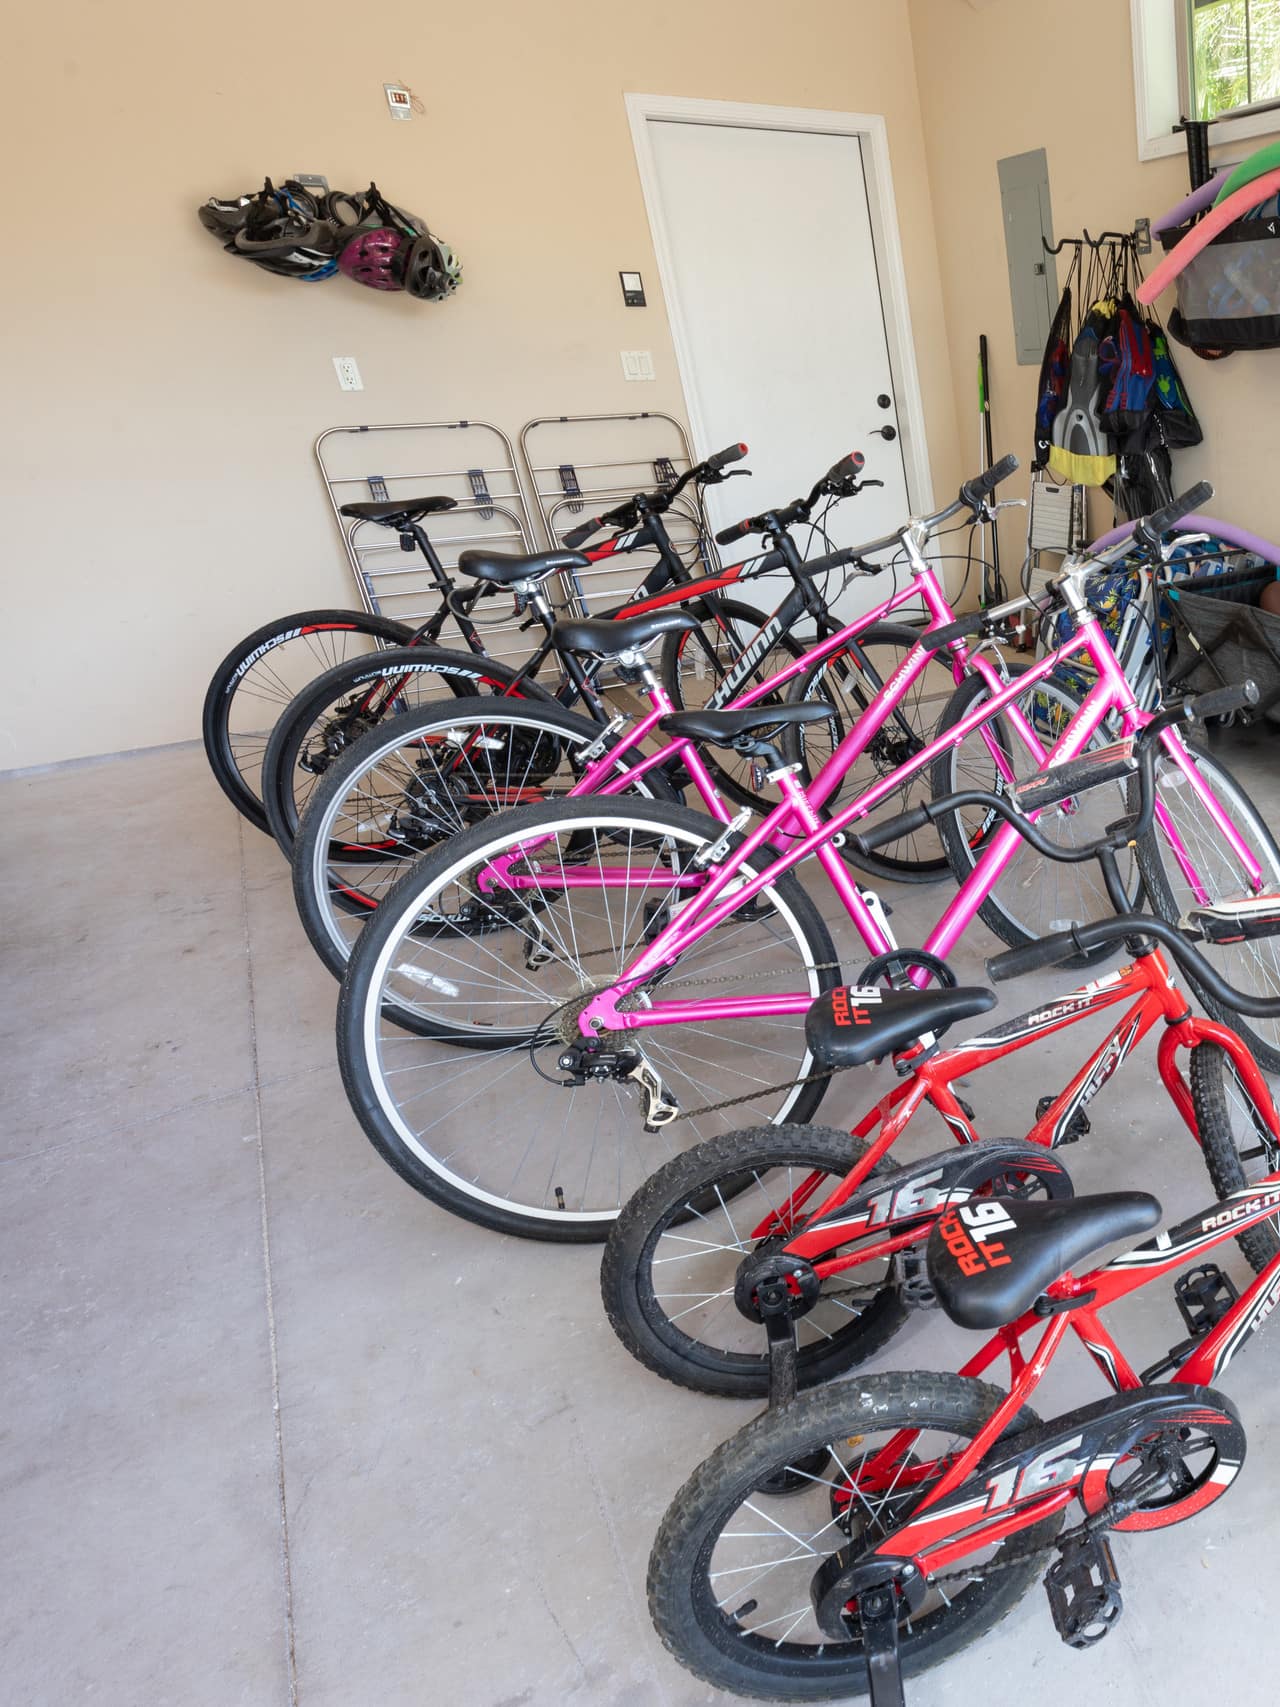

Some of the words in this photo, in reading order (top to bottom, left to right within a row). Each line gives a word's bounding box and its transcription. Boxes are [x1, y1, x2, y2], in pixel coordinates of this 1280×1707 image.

[236, 632, 285, 677] SCHWINN
[382, 664, 460, 677] SCHWINN
[703, 617, 783, 711] CHWINN
[832, 986, 852, 1026] ROC
[850, 985, 883, 1007] 16
[1028, 1001, 1075, 1026] ROCK
[865, 1168, 944, 1227] 16
[1200, 1199, 1261, 1232] ROCK
[959, 1201, 1018, 1243] 16
[984, 1433, 1084, 1513] 16
